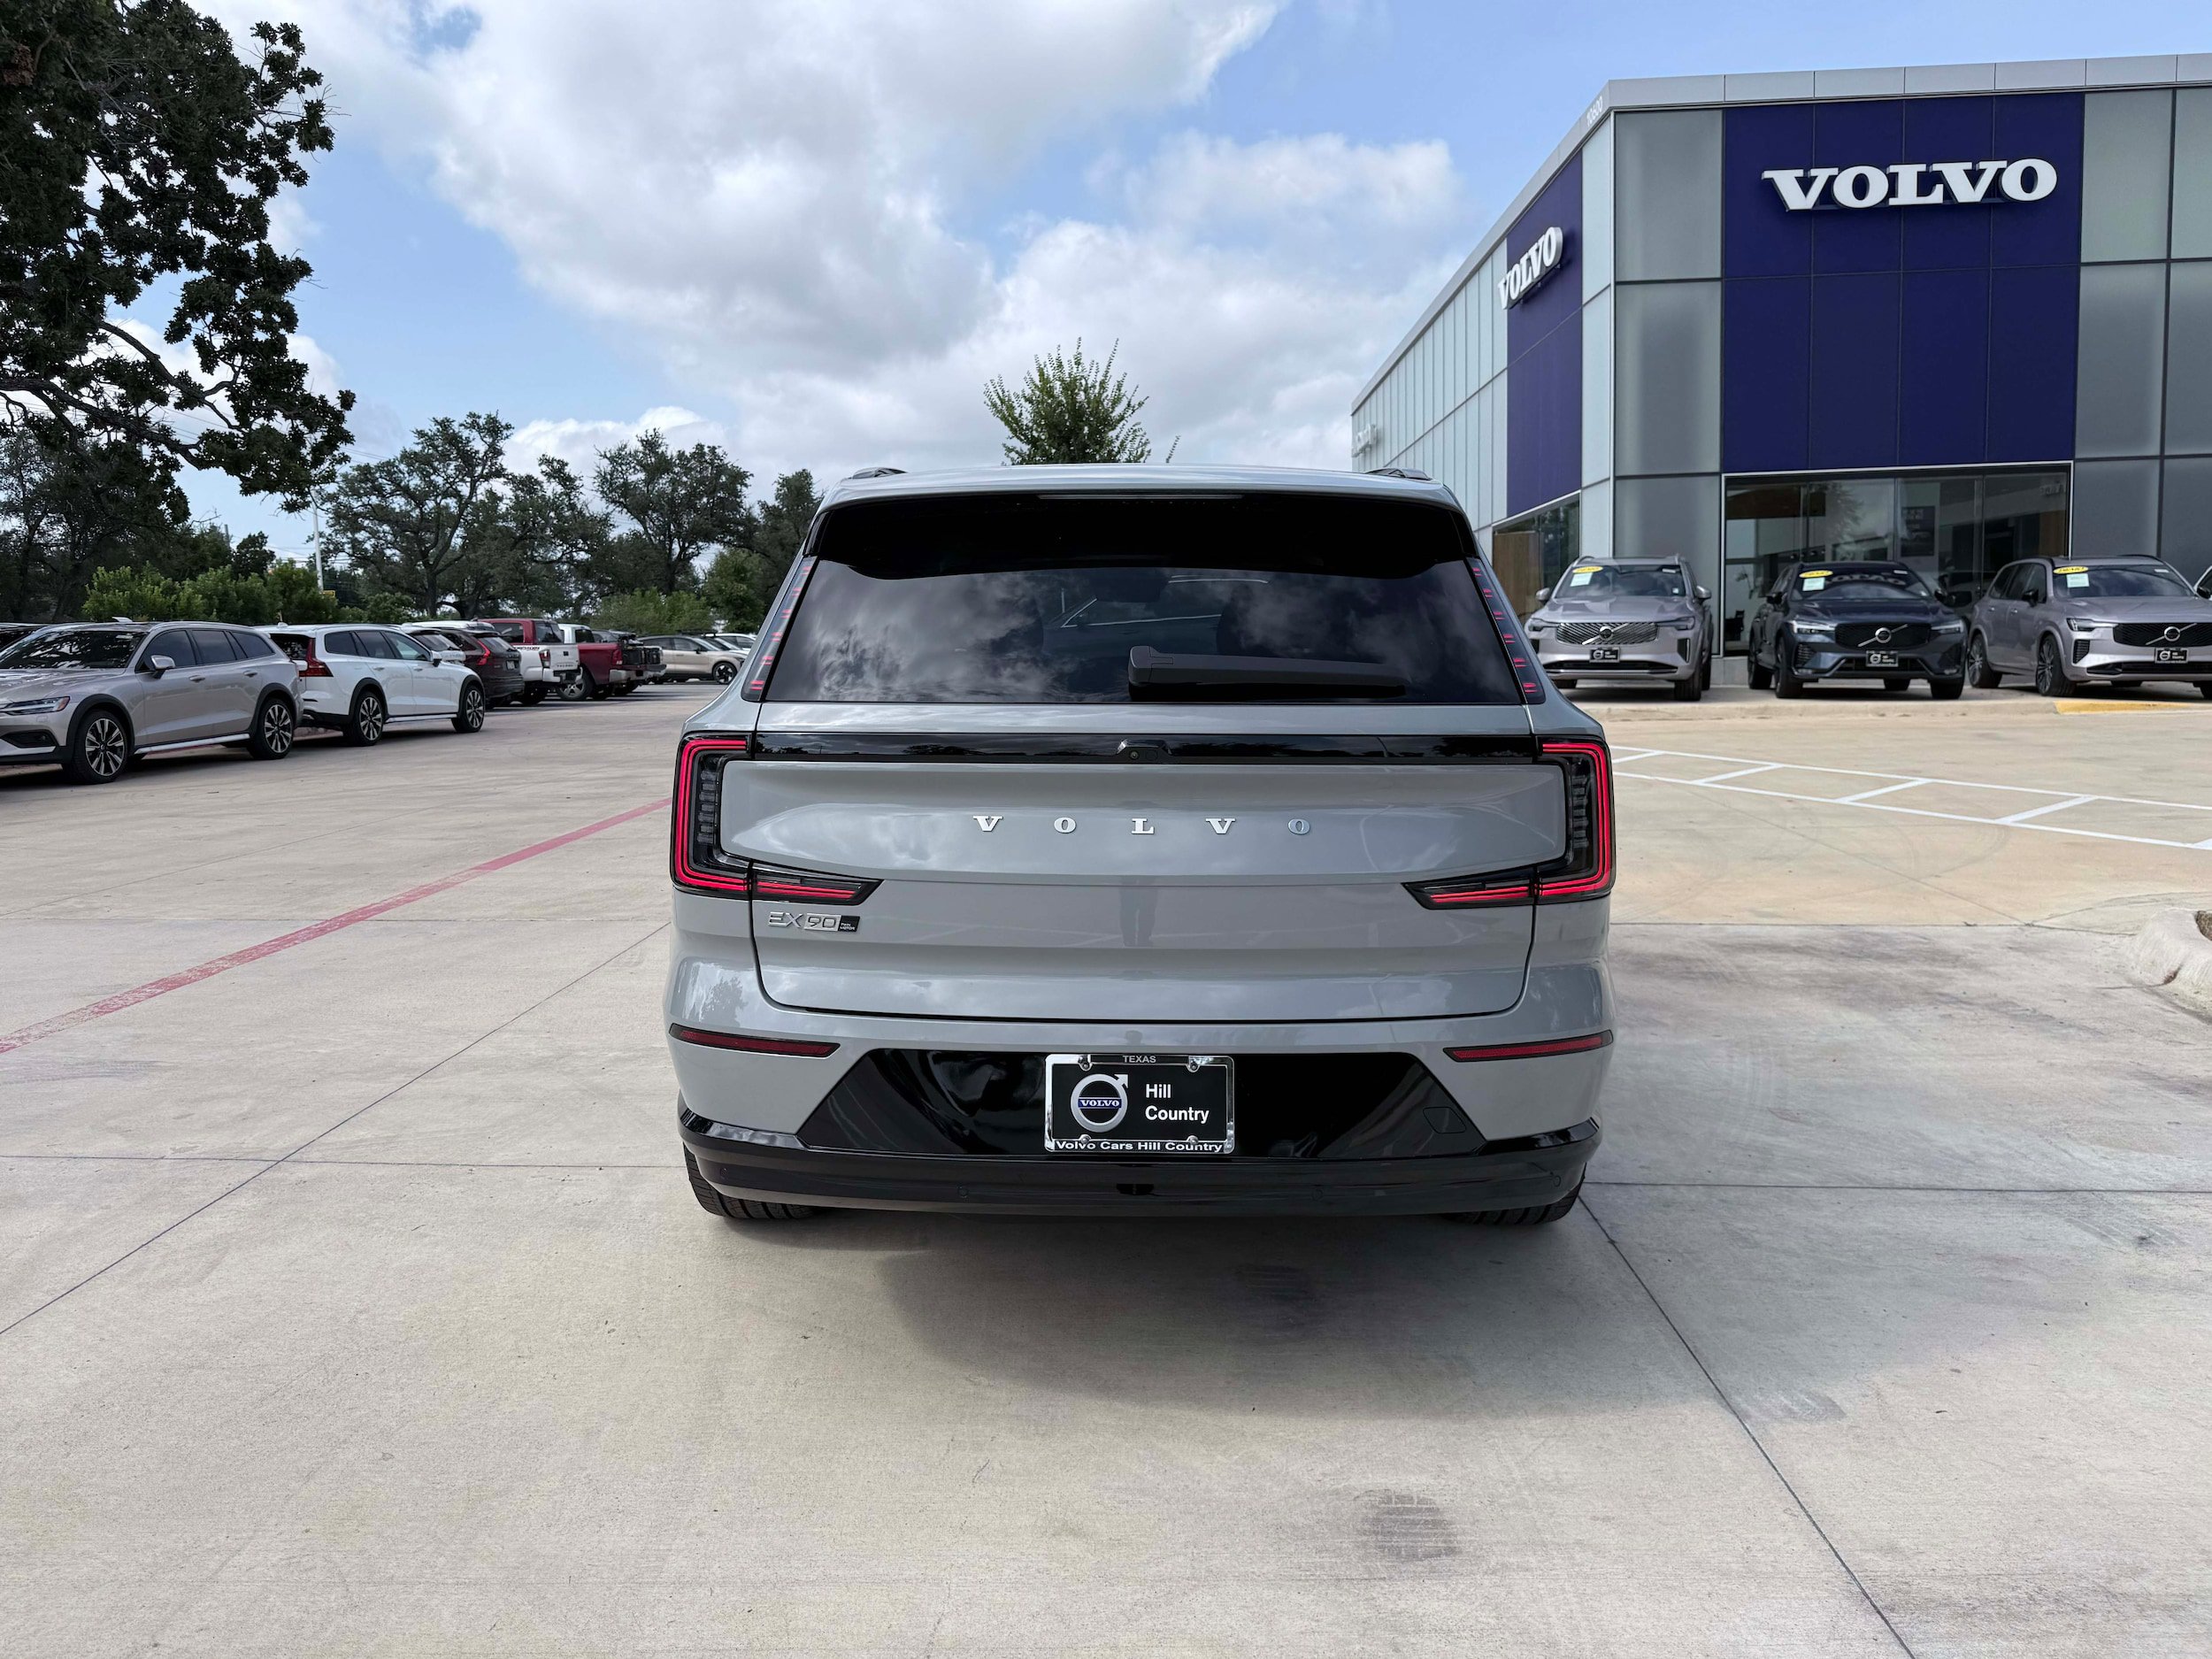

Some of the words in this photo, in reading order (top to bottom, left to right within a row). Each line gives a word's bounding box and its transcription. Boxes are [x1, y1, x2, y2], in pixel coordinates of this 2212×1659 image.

[1763, 158, 2058, 211] VOLVO
[1497, 227, 1563, 310] VOLVO
[973, 815, 1311, 834] VOLVO
[768, 911, 841, 932] EX90
[1122, 1055, 1157, 1064] TEXAS
[1145, 1083, 1171, 1099] Hill
[1145, 1105, 1210, 1124] Country
[1056, 1141, 1096, 1150] Volvo
[1100, 1141, 1133, 1150] Cars
[1138, 1141, 1161, 1150] Hill
[1165, 1142, 1223, 1153] Country
